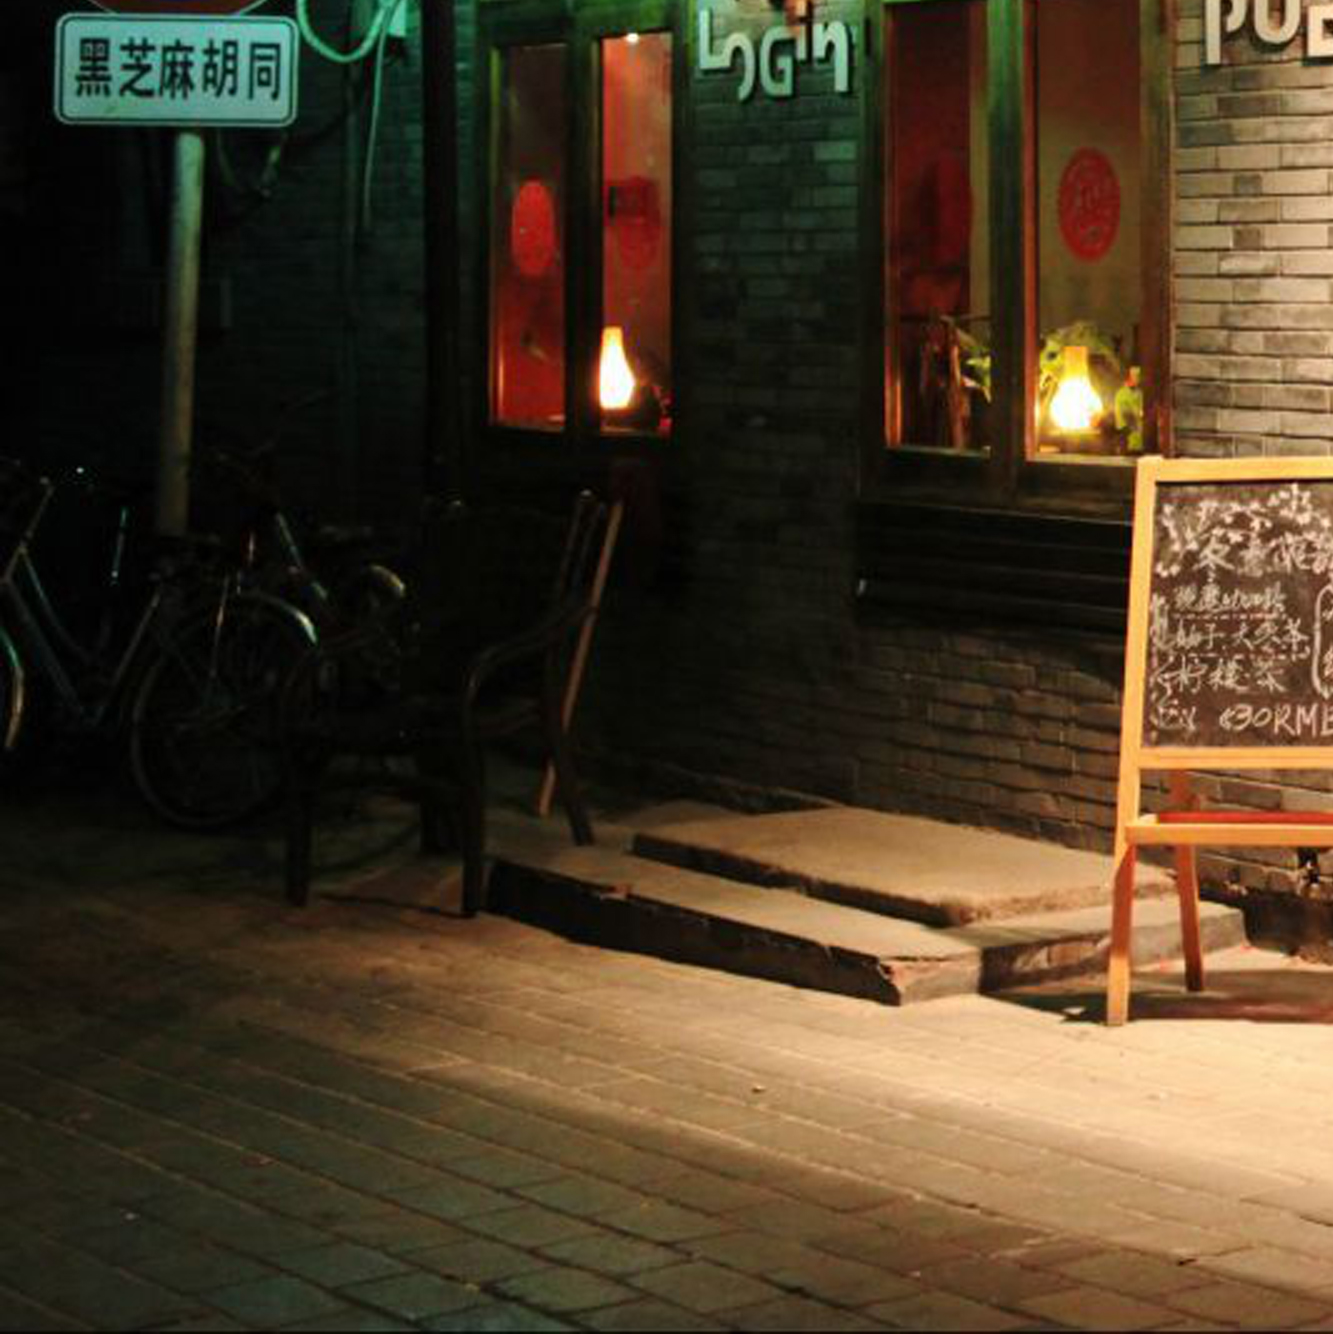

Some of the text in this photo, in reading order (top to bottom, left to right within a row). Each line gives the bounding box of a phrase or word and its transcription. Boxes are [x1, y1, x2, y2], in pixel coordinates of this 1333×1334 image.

[74, 36, 282, 102] 黑芝麻胡同
